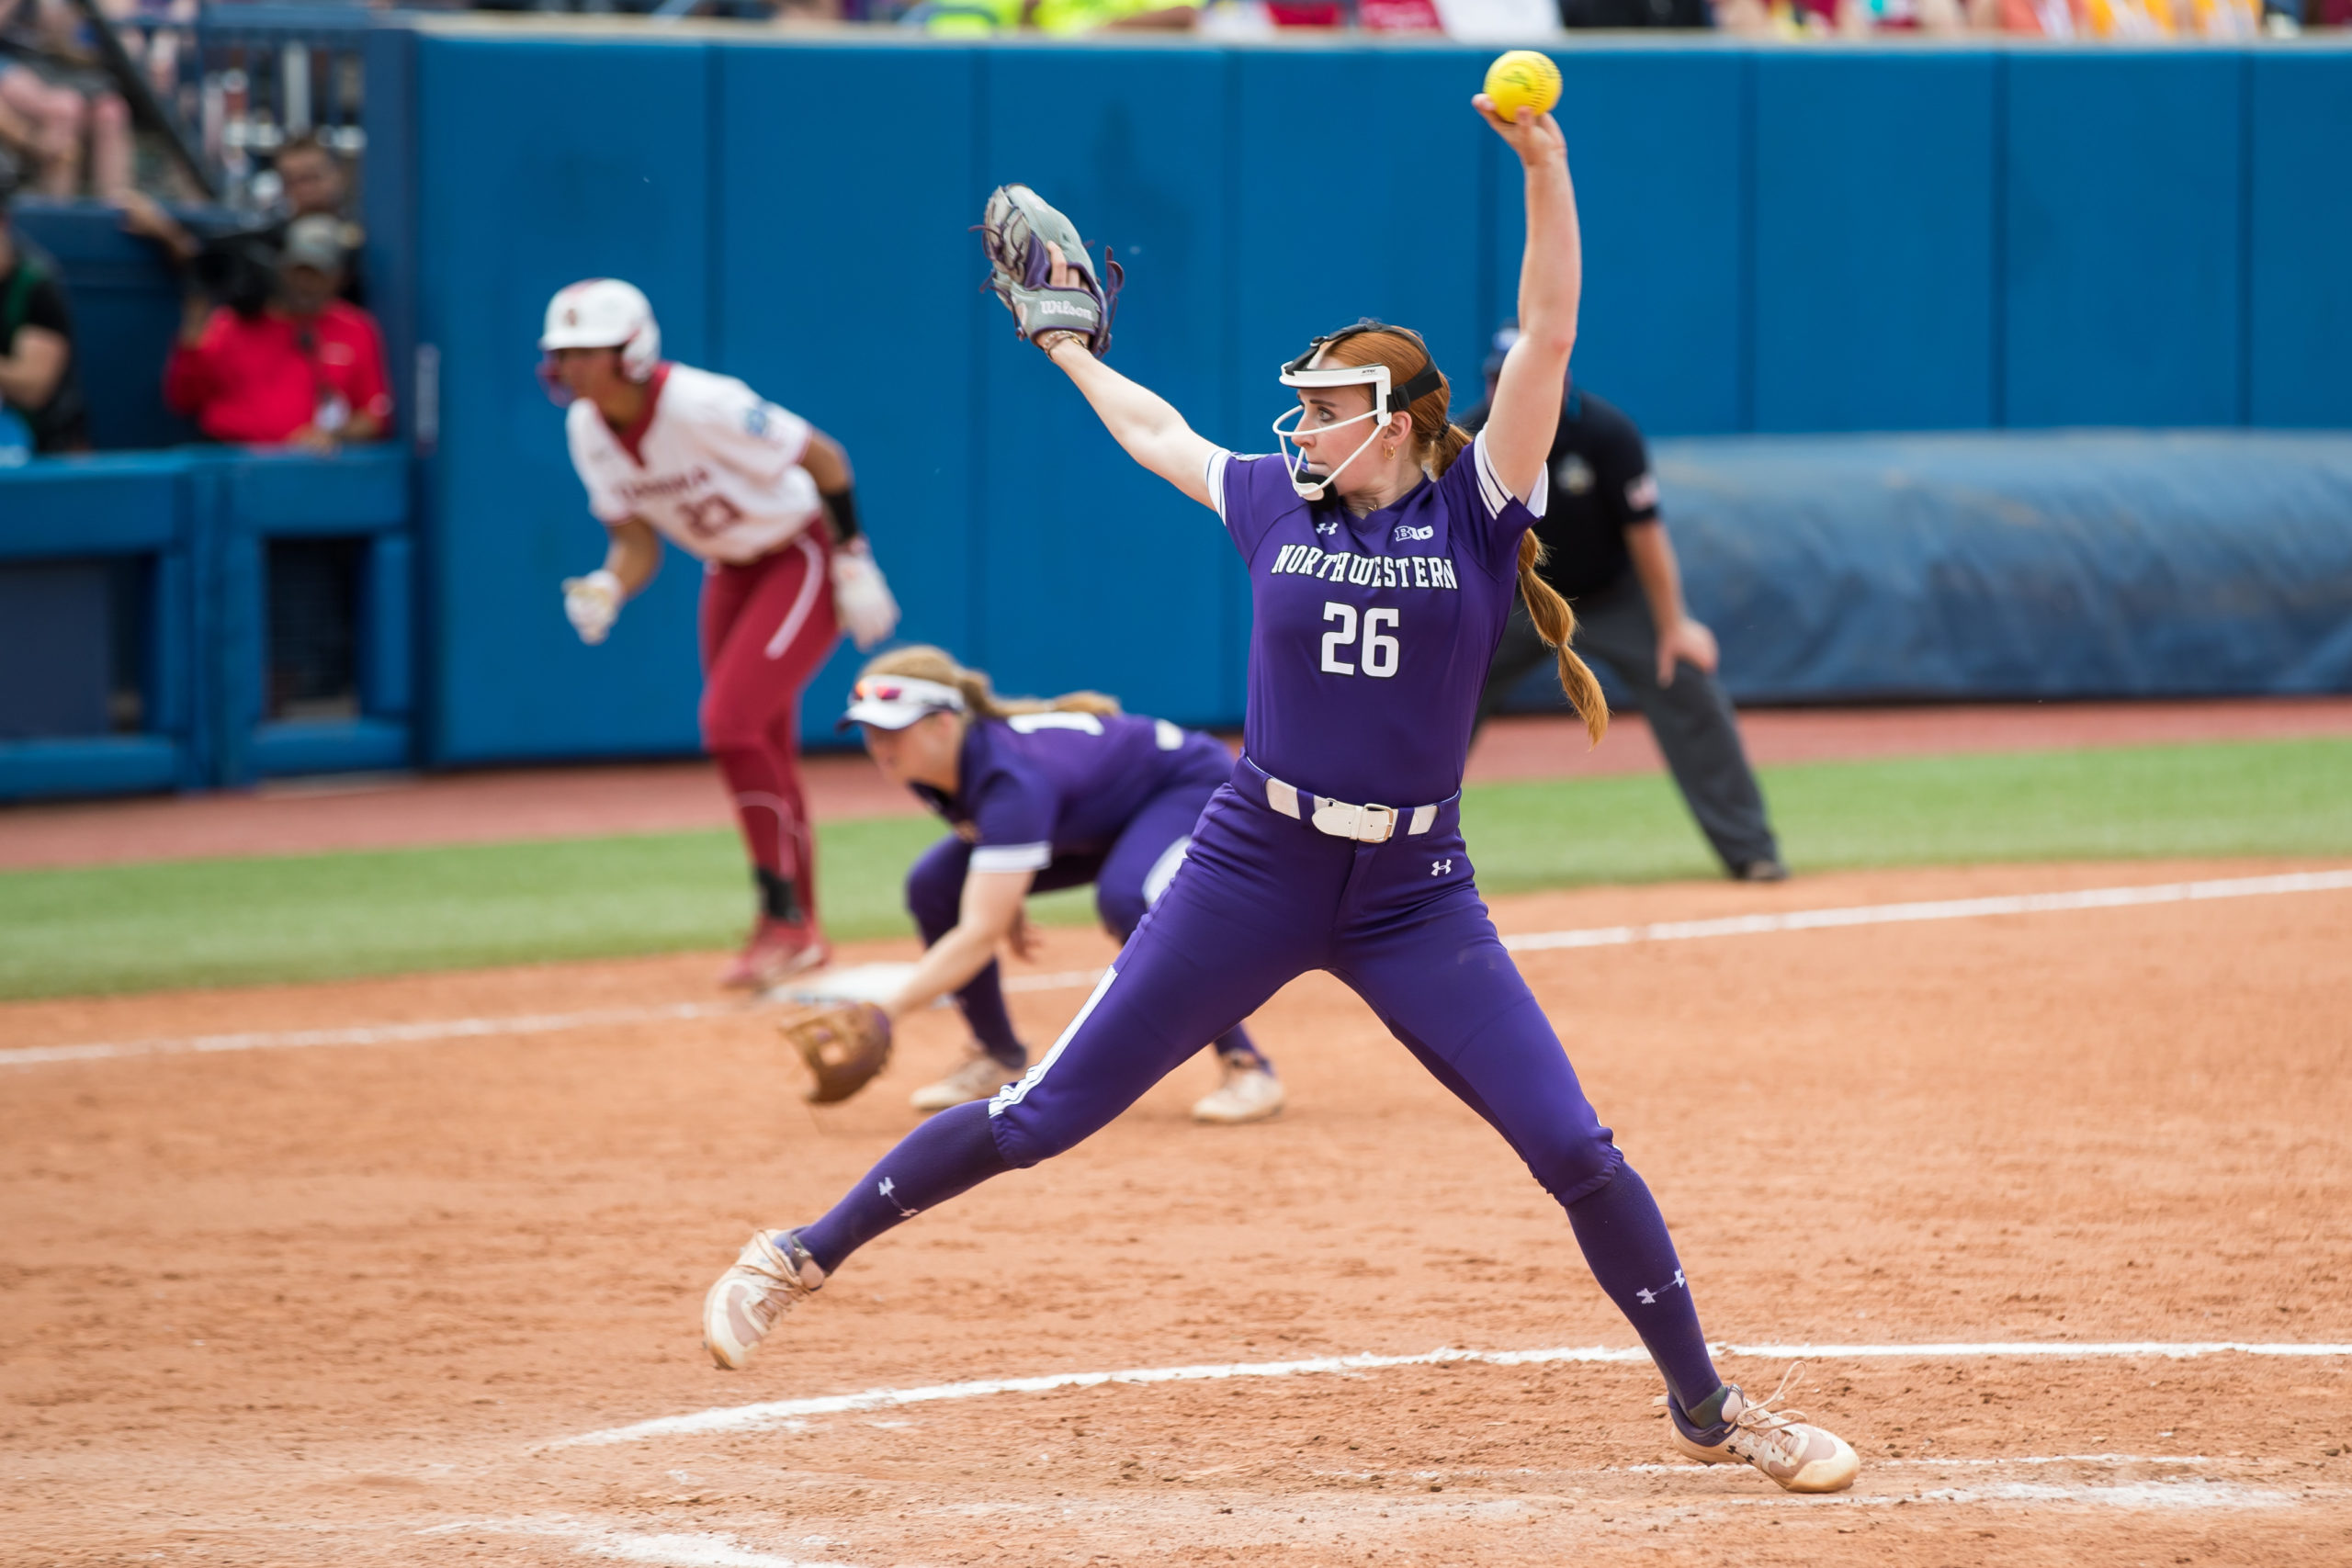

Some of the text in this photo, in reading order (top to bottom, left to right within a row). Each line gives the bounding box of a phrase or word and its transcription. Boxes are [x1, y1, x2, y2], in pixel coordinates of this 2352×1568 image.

[1040, 300, 1095, 321] Wilson
[1271, 543, 1459, 590] NORTHWESTERN
[1320, 601, 1400, 678] 26
